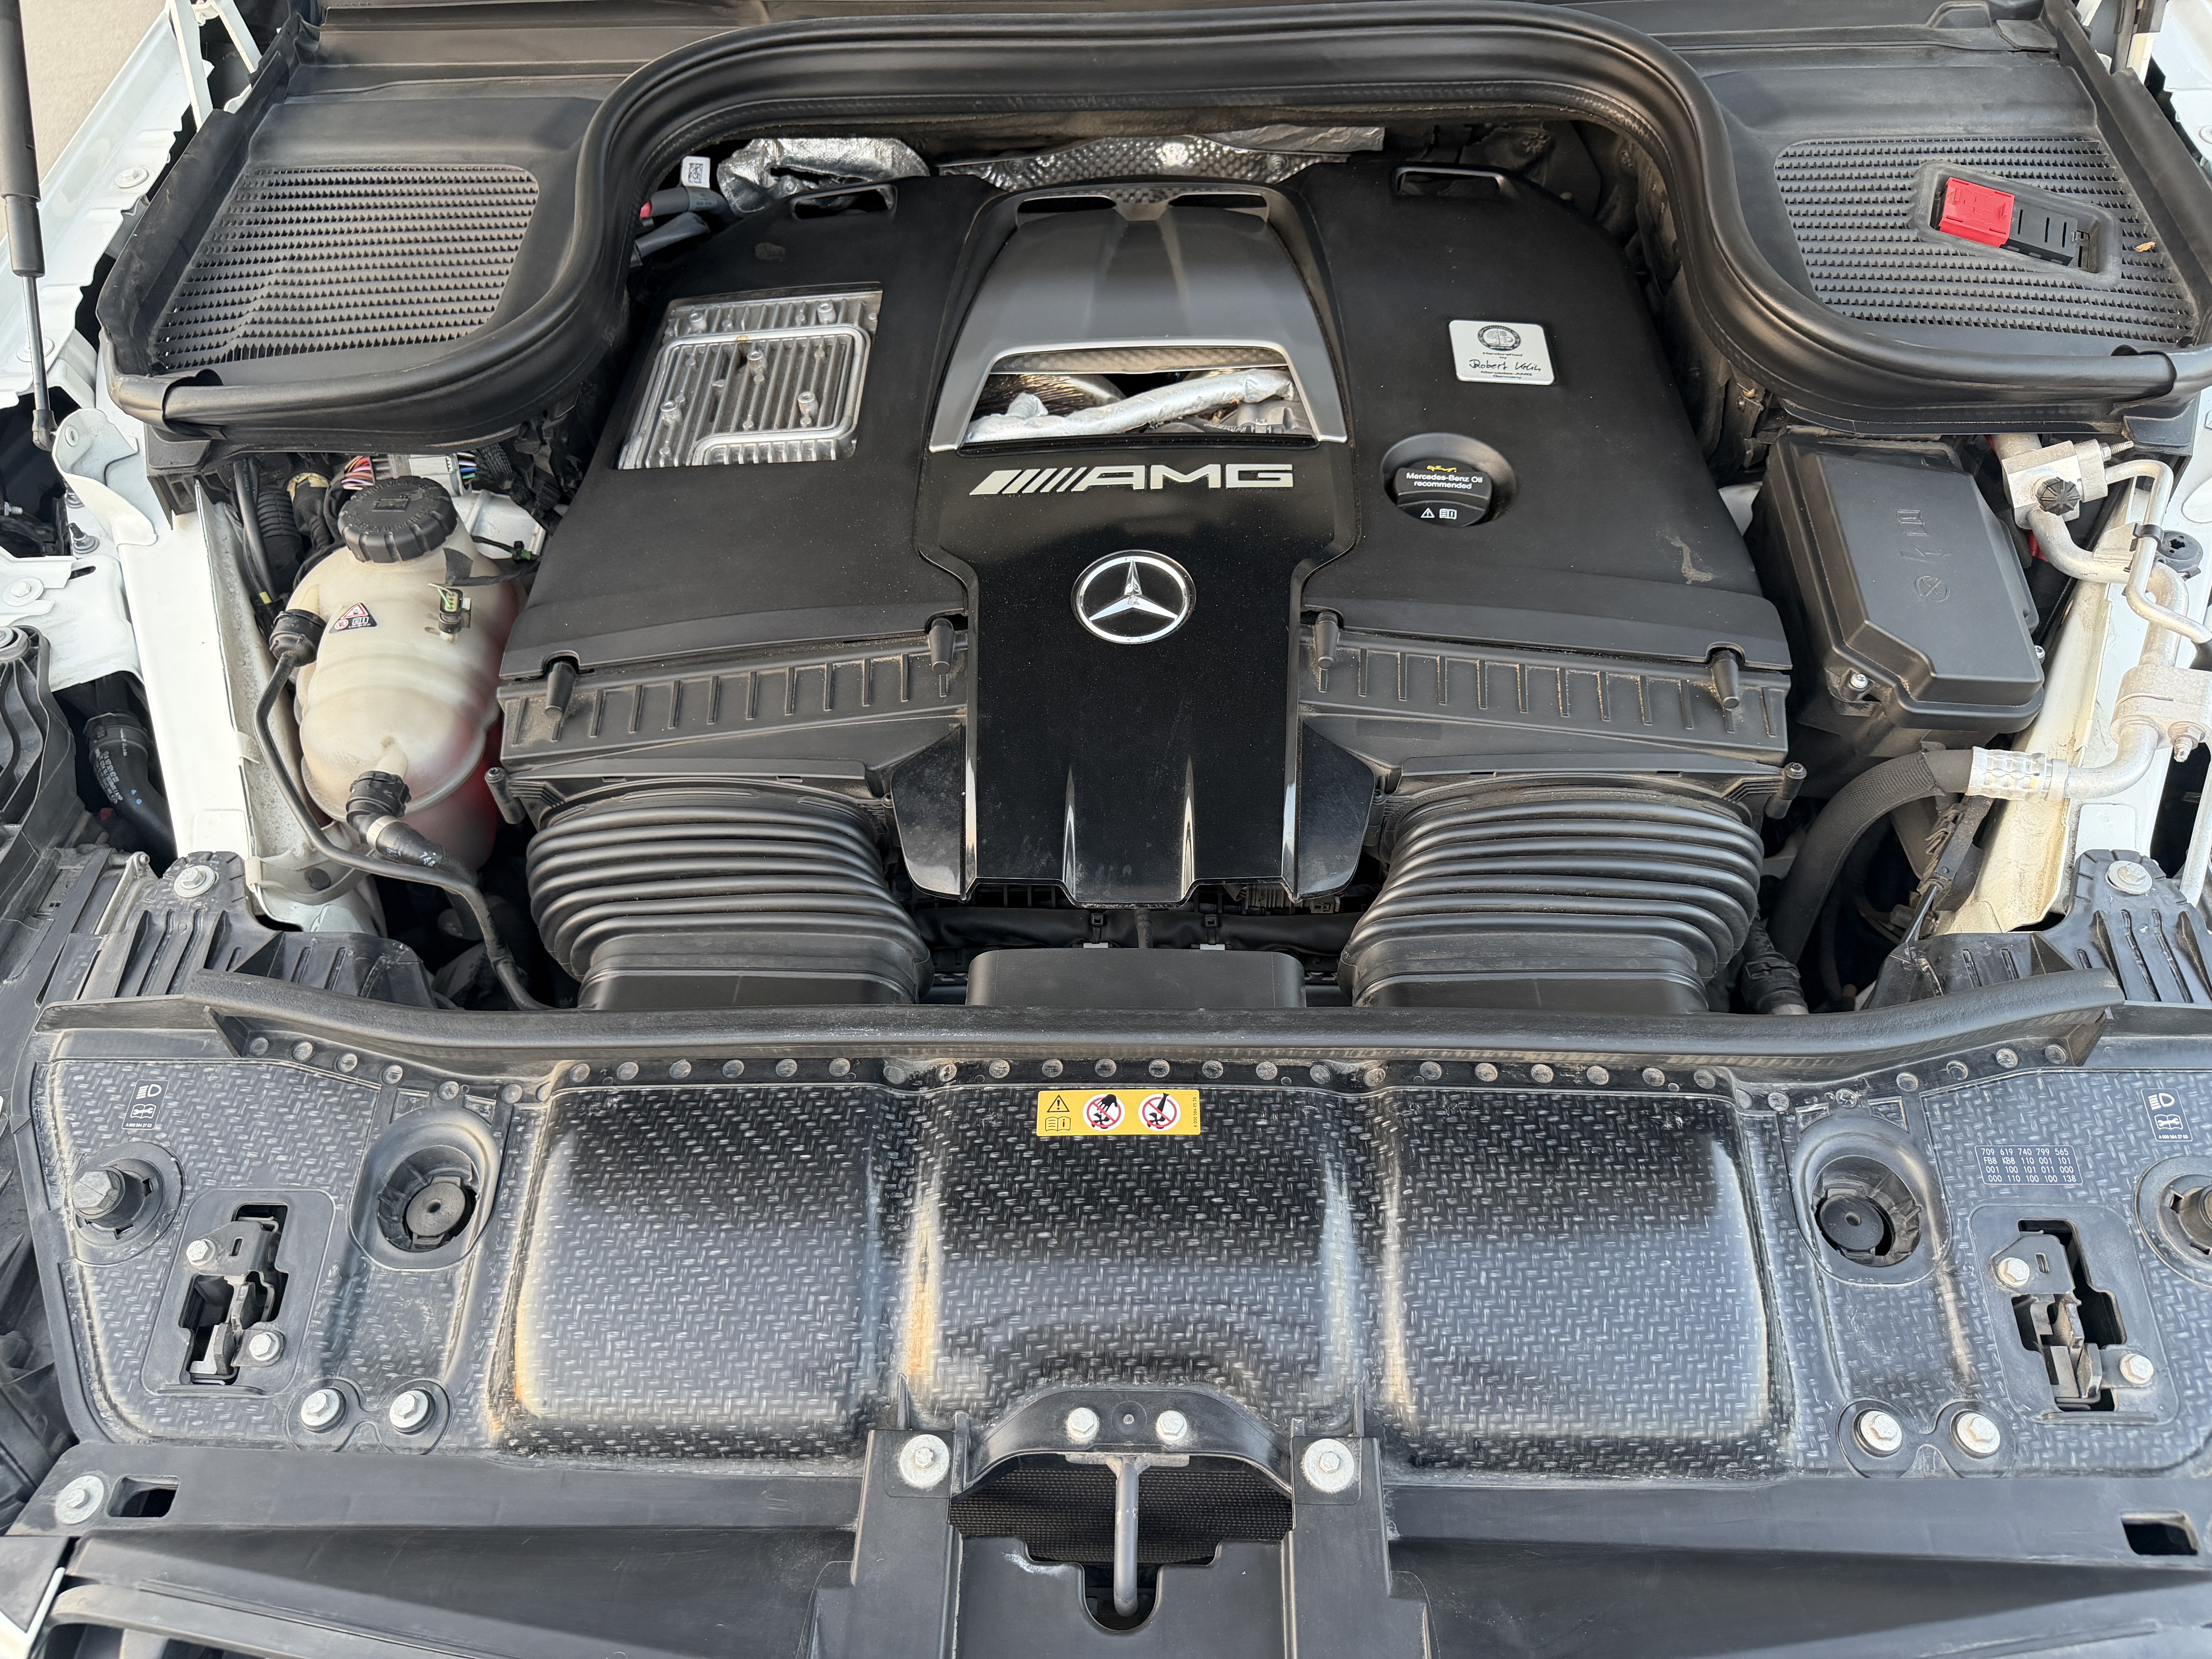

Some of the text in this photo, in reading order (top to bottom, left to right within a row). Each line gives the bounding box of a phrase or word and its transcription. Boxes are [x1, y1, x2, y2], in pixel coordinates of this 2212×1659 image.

[1469, 359, 1508, 370] Robert
[1071, 464, 1293, 493] AMG
[1406, 472, 1469, 482] Mercedes-Benz
[1414, 480, 1472, 489] recommended
